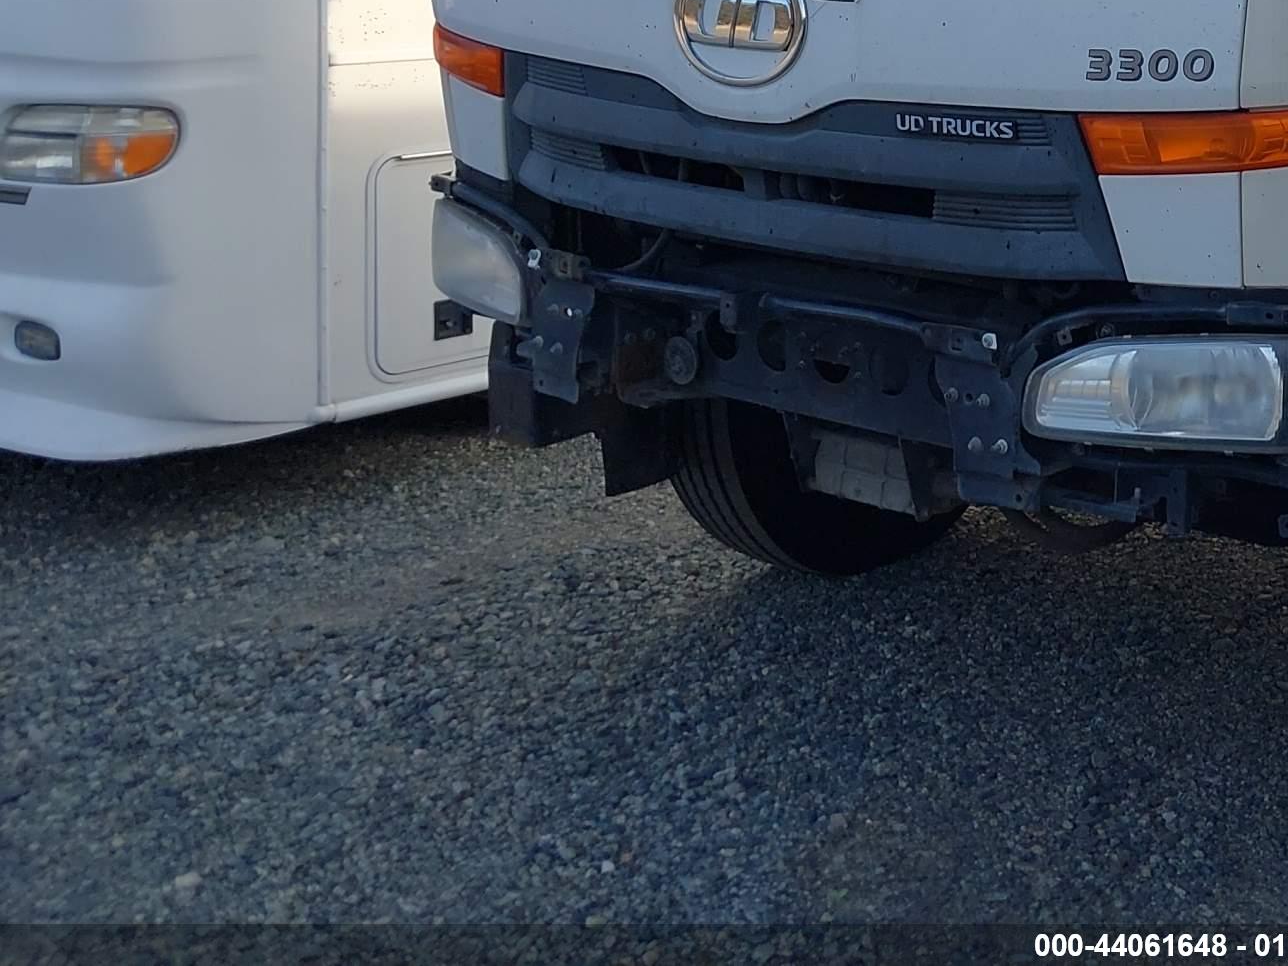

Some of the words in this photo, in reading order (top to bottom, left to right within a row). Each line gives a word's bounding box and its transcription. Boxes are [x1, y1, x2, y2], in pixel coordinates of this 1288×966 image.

[1086, 49, 1215, 82] 3300
[896, 114, 924, 131] UD
[928, 116, 1013, 139] TRUCKS
